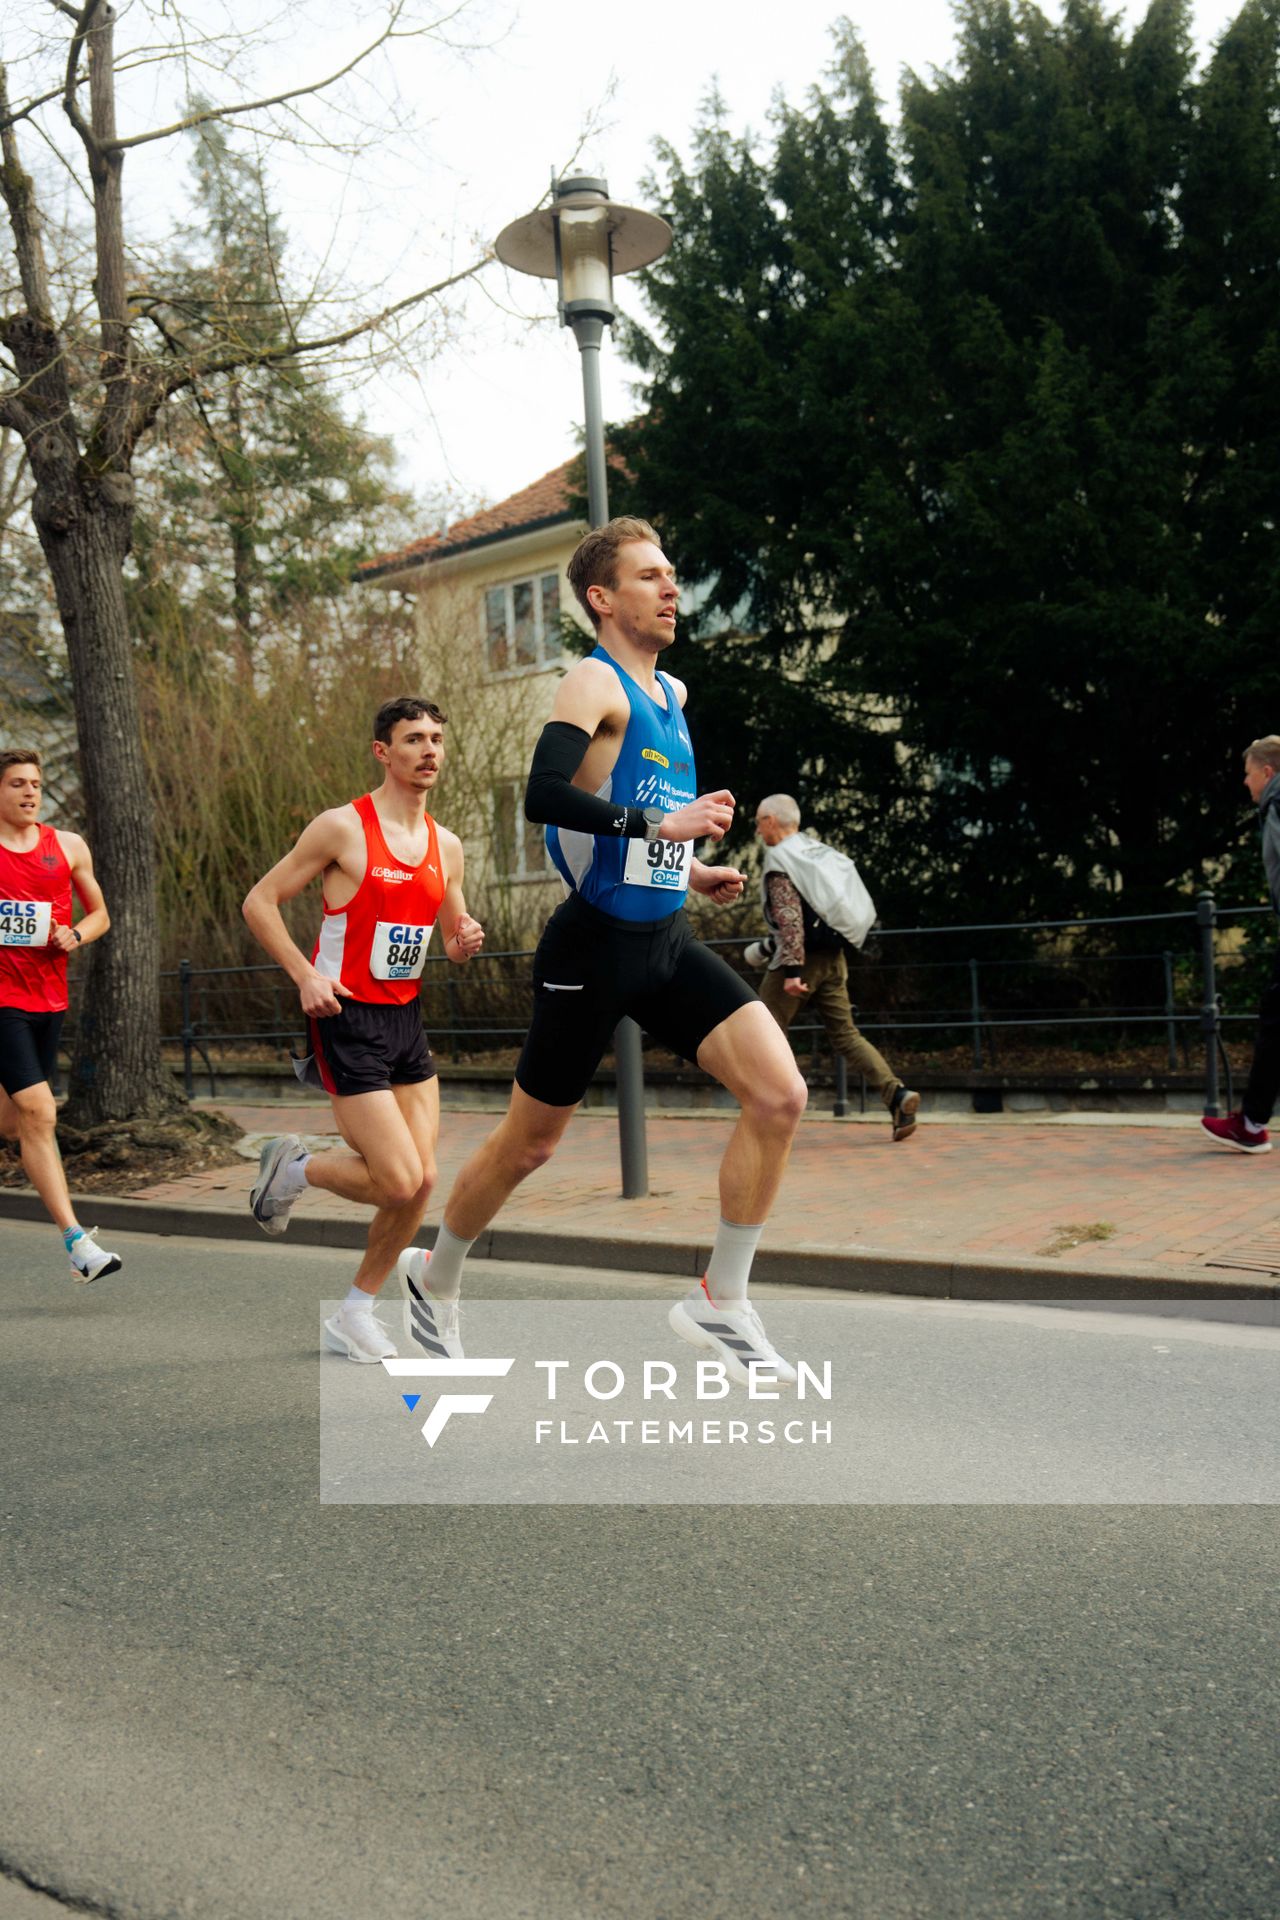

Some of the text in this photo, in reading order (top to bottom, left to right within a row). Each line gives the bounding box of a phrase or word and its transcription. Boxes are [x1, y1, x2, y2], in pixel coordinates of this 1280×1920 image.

[646, 840, 685, 871] 932
[0, 917, 37, 935] 436
[386, 944, 421, 966] 848
